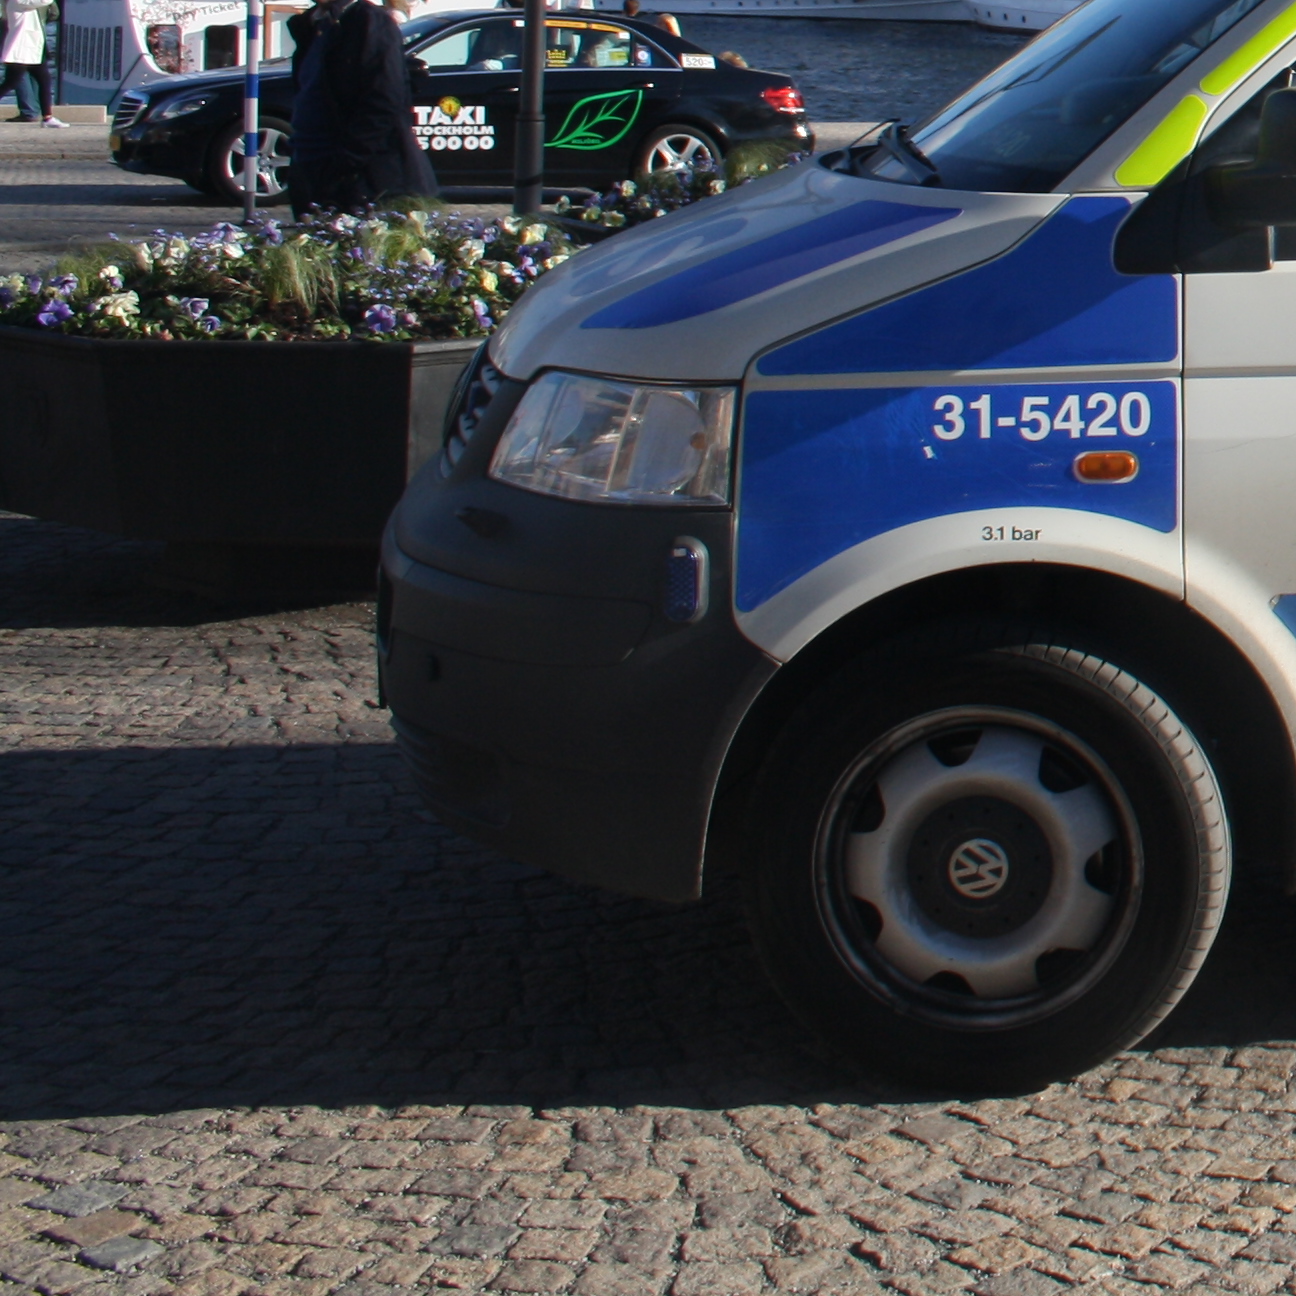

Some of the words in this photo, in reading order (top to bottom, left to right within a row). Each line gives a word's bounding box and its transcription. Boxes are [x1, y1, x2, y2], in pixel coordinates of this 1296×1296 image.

[413, 105, 486, 125] TAXI
[411, 125, 495, 136] TOCKHOLM
[933, 391, 1152, 441] 31-5420
[982, 526, 1005, 541] 3.1
[1011, 526, 1042, 541] bar
